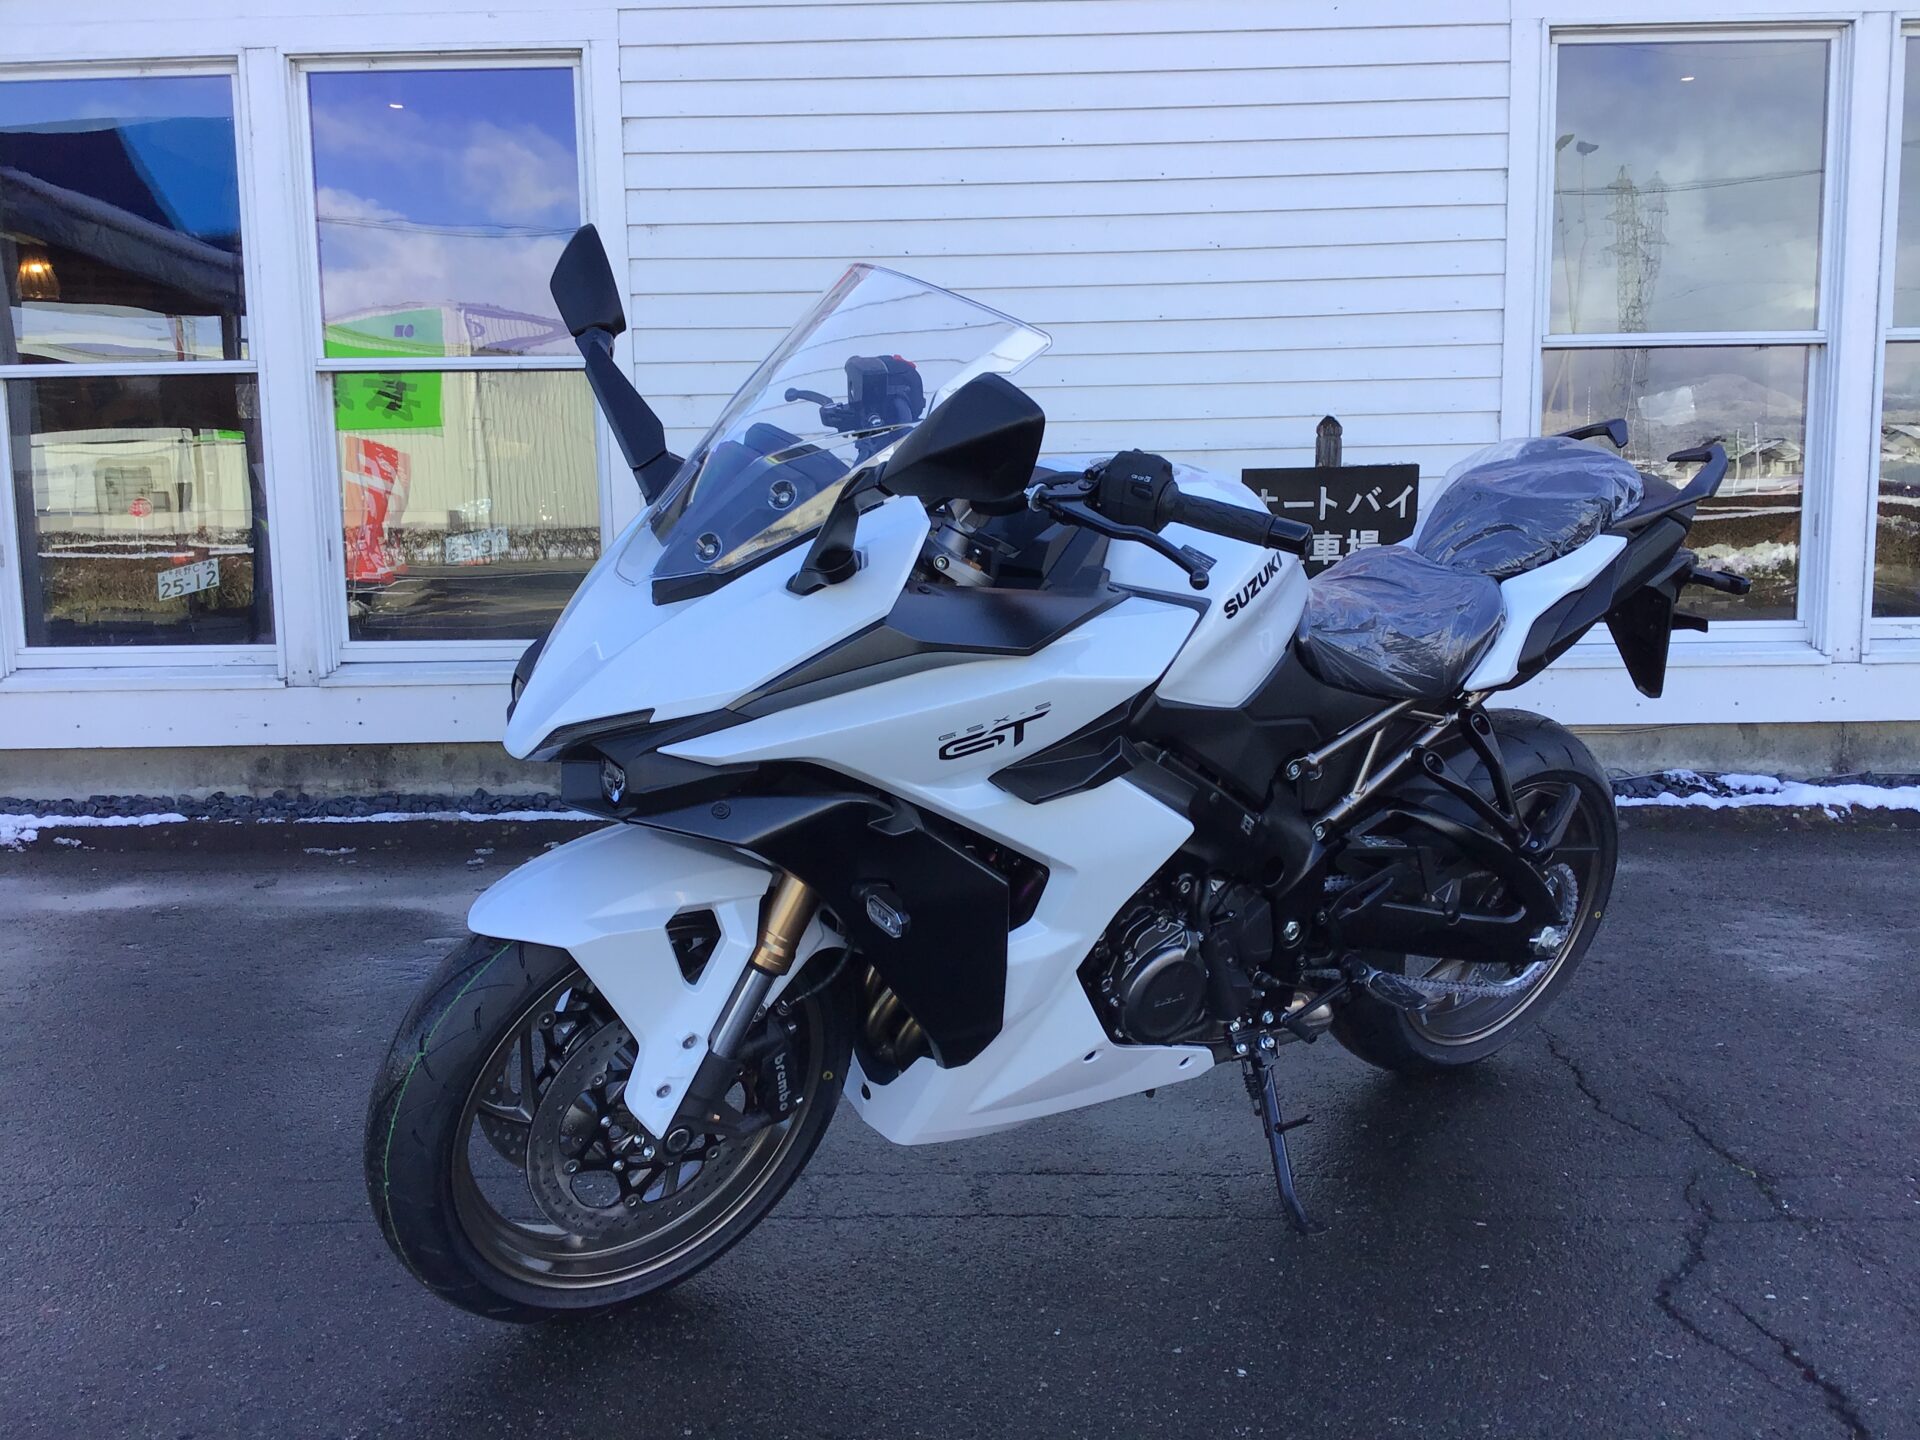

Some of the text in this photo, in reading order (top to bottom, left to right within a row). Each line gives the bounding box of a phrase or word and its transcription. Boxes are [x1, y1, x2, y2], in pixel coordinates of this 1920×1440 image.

[161, 570, 217, 599] 25-12
[1223, 550, 1283, 620] SUZUKI
[938, 701, 1052, 742] GSX-S
[938, 709, 1051, 760] GT
[774, 1052, 792, 1112] brembo
